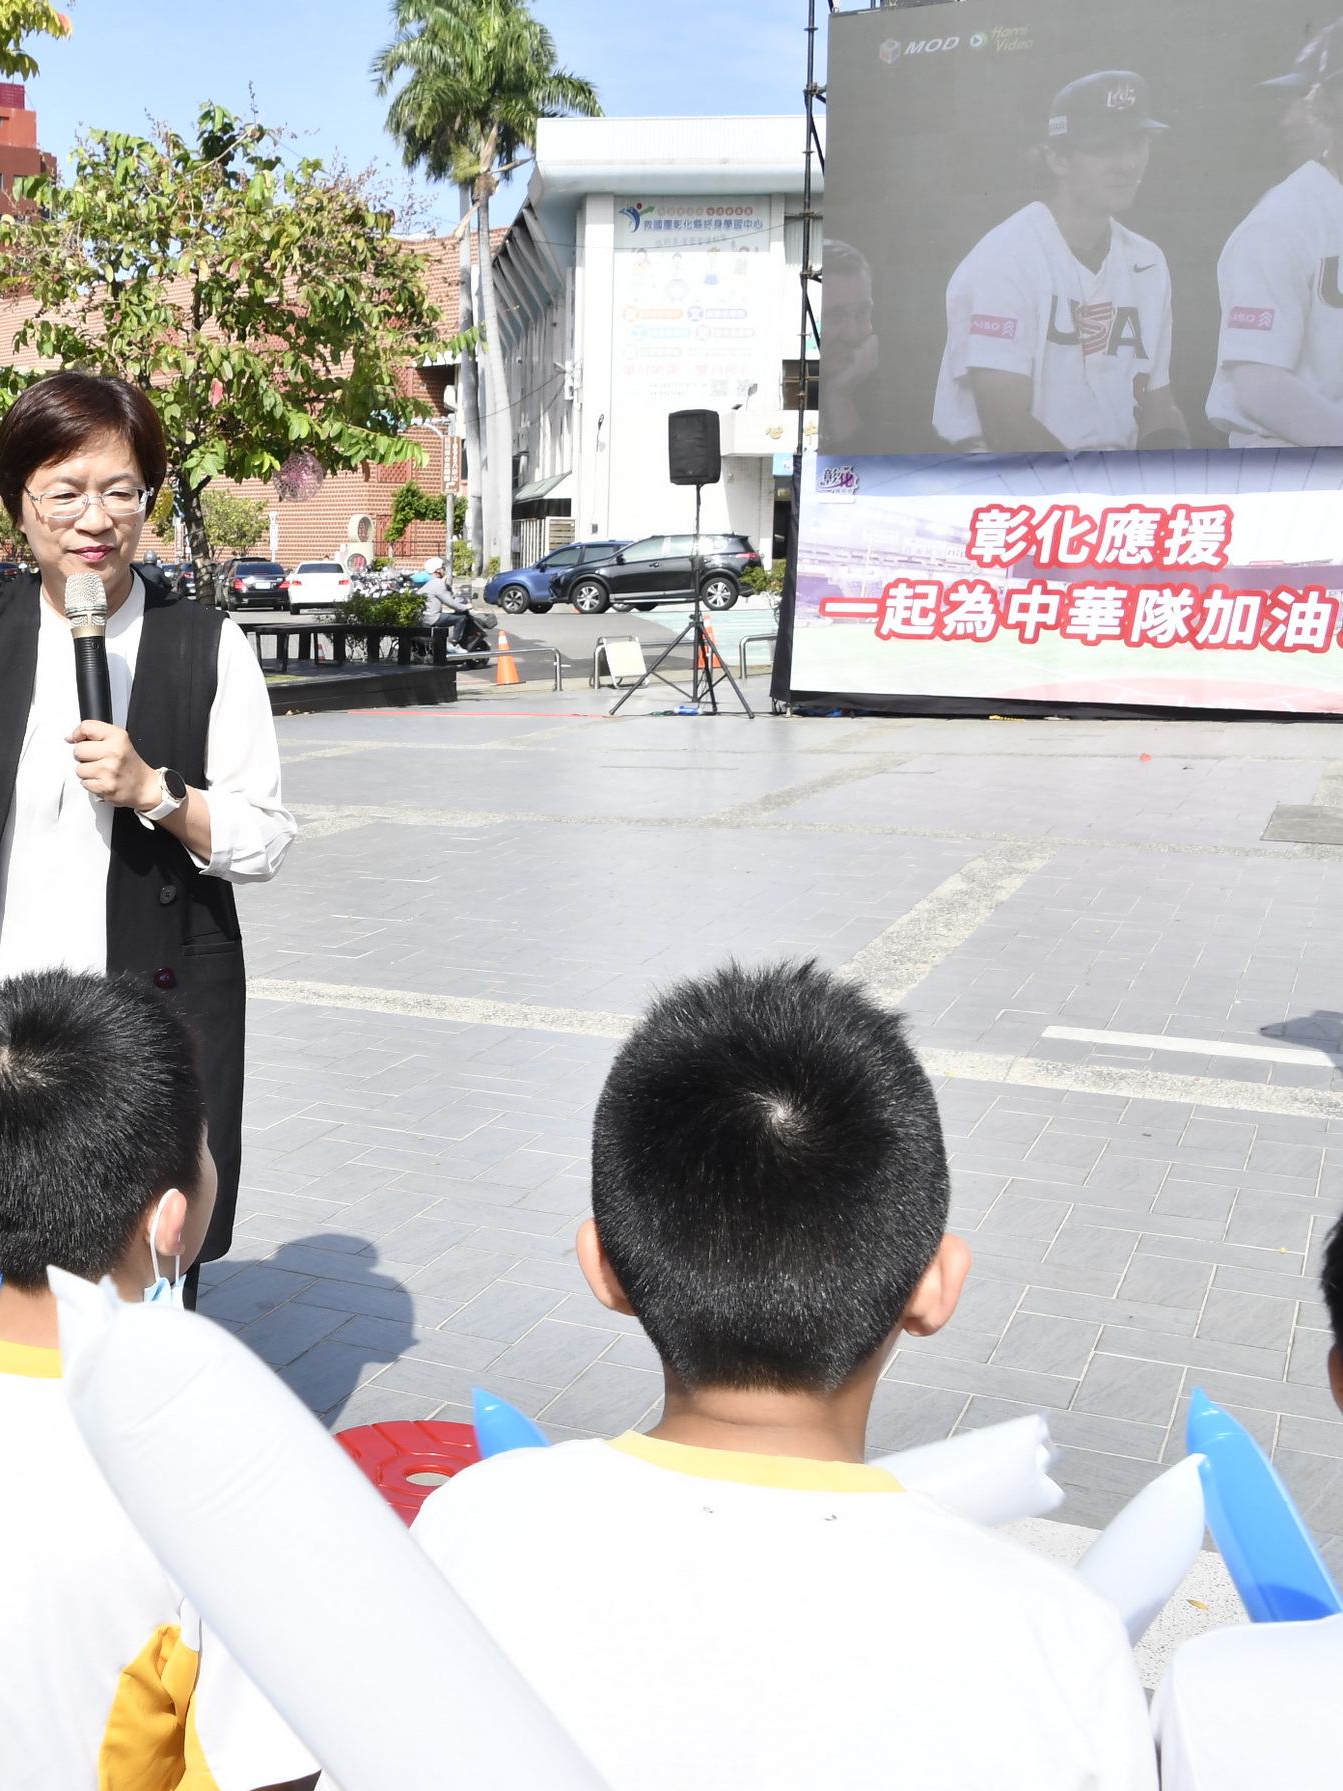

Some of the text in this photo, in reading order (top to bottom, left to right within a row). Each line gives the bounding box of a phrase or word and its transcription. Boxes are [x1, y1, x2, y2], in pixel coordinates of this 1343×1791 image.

[904, 36, 960, 55] MOD
[991, 25, 1029, 39] Hami
[995, 38, 1034, 52] Video
[1046, 295, 1150, 360] USA
[974, 508, 1228, 568] 彰化應援
[821, 582, 1335, 649] 一起為中華隊加油
